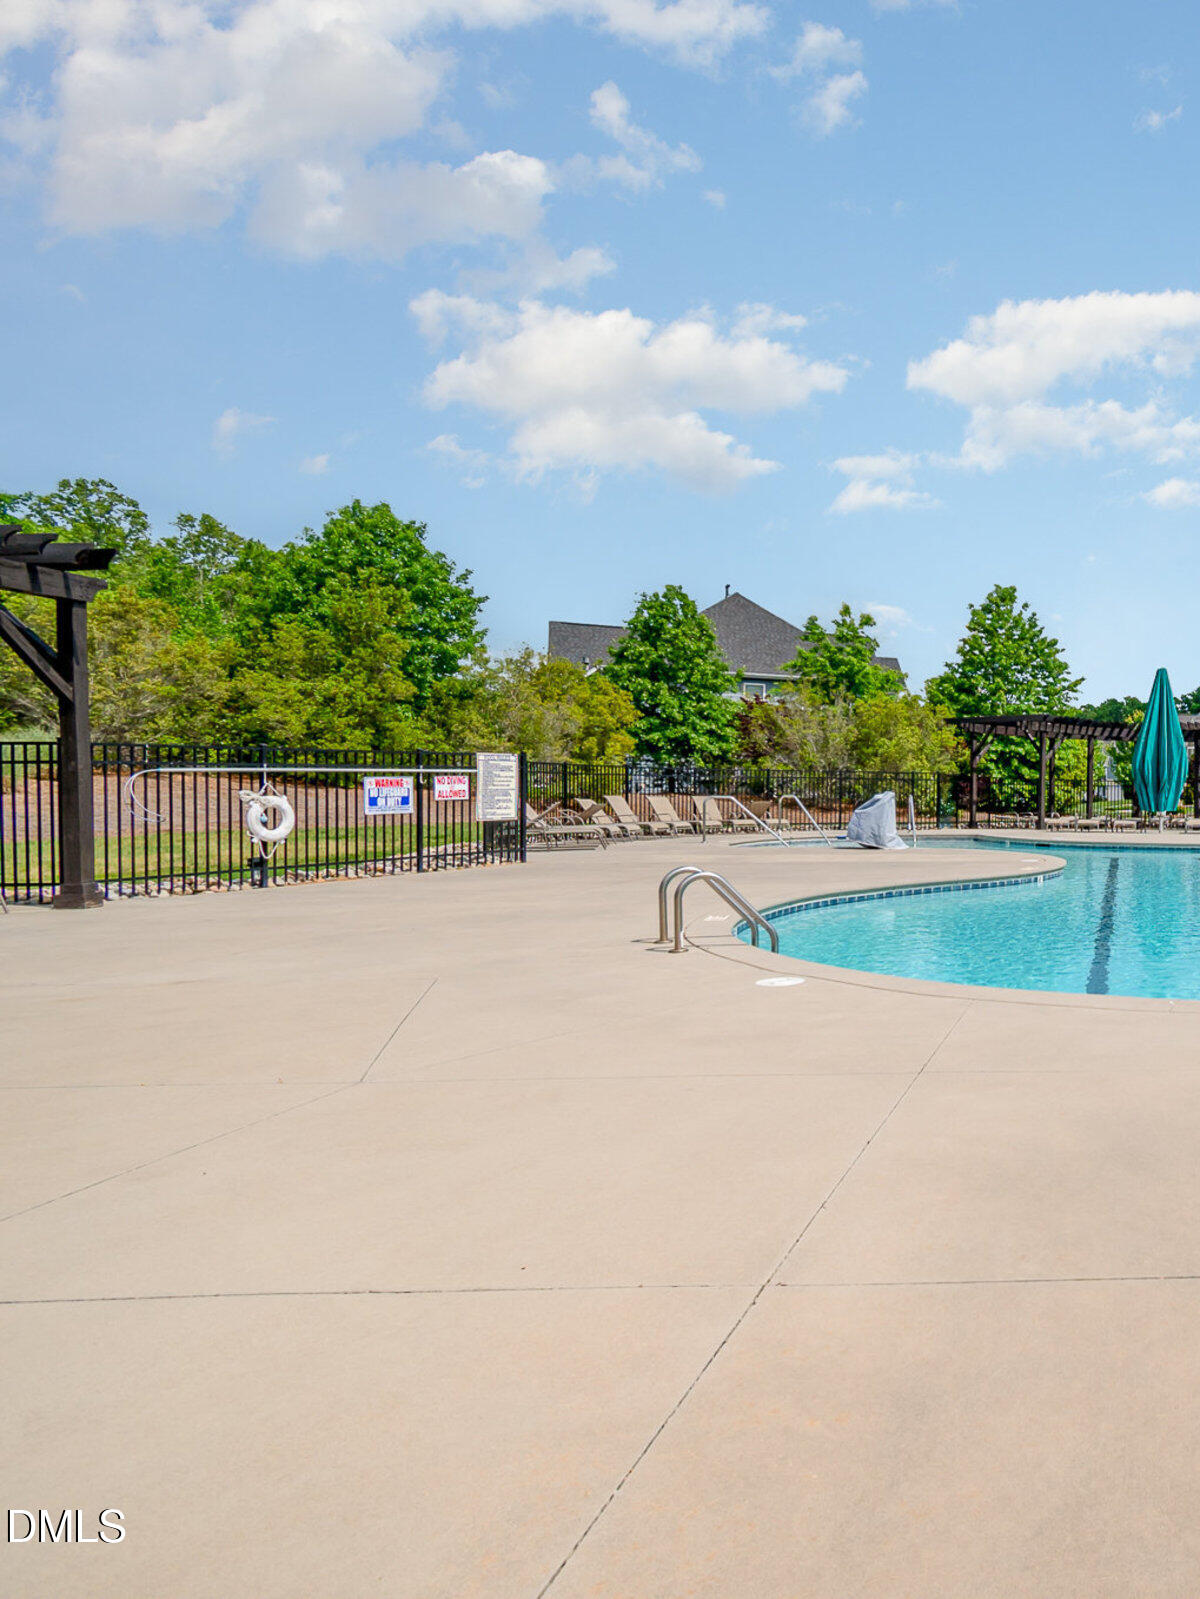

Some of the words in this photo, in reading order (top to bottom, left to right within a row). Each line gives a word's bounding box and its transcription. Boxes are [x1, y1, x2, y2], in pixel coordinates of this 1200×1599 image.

[374, 778, 404, 788] WARNING
[436, 776, 445, 785] NO
[447, 776, 466, 785] DIVING
[437, 789, 466, 798] ALLOWED
